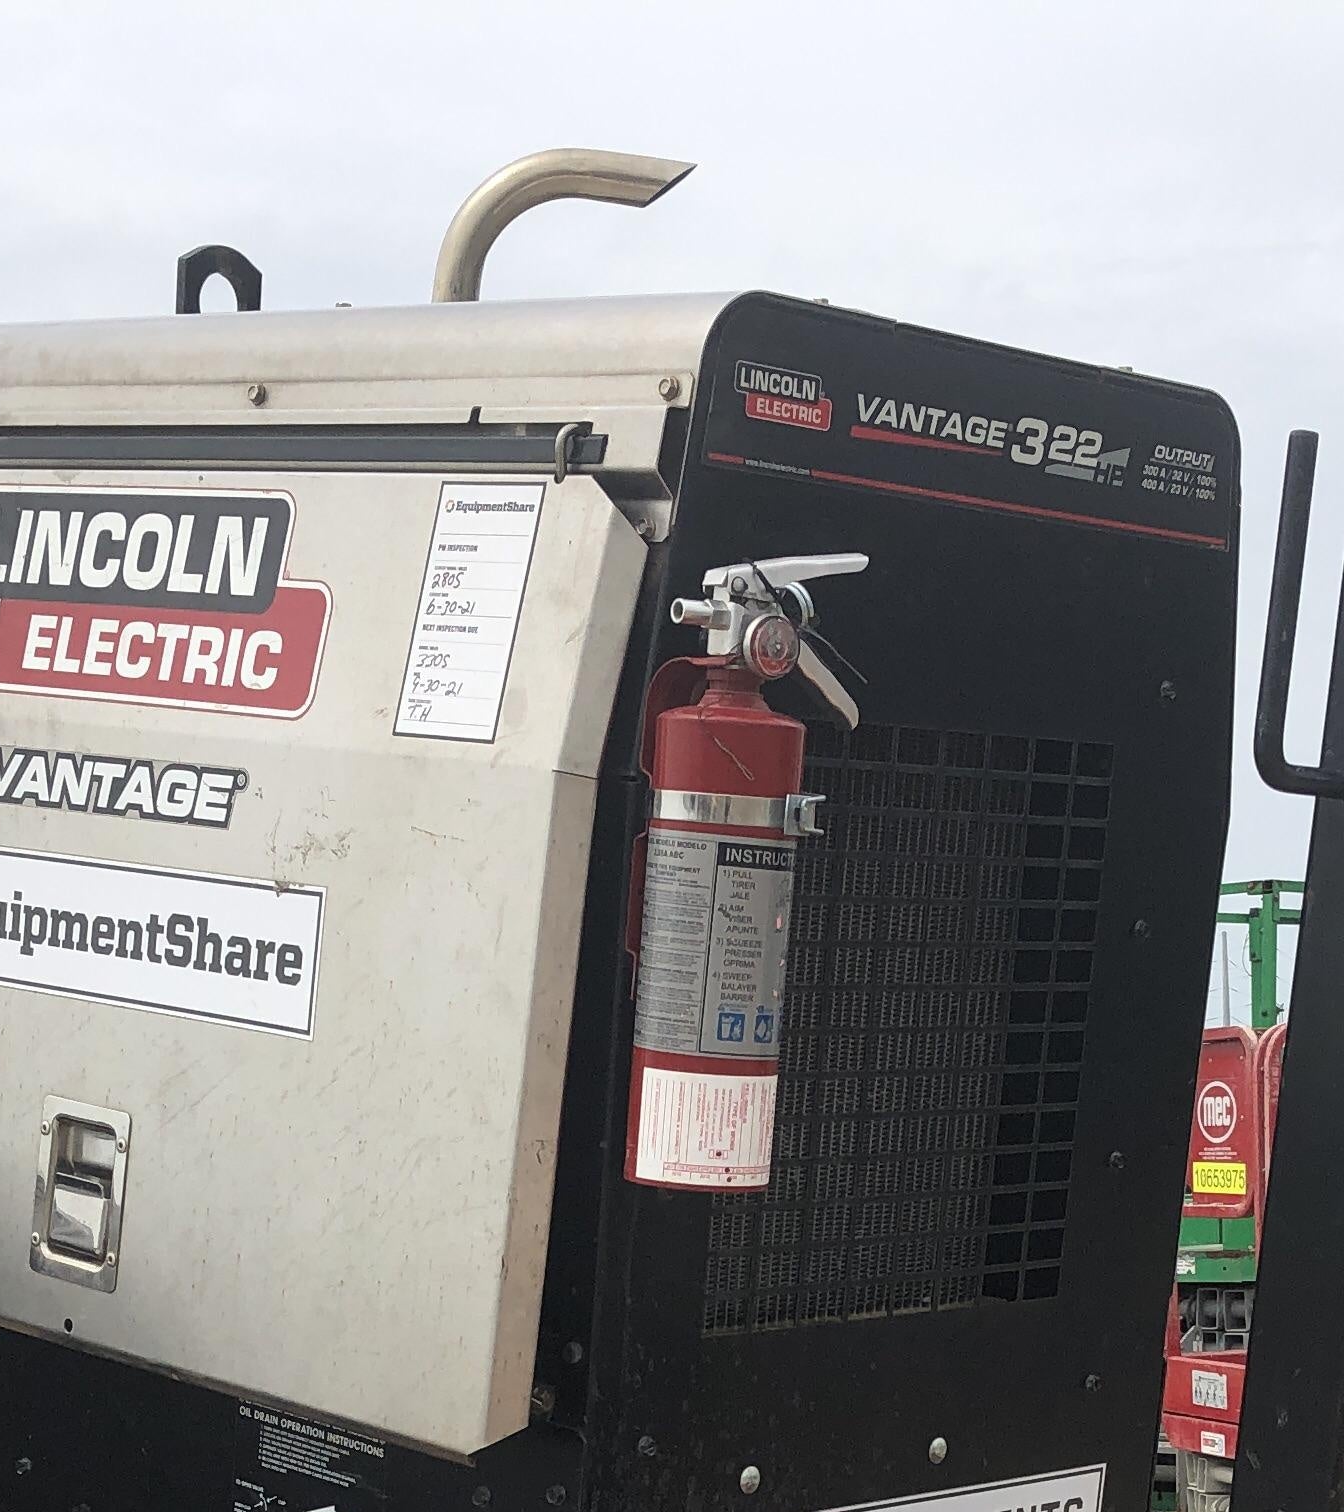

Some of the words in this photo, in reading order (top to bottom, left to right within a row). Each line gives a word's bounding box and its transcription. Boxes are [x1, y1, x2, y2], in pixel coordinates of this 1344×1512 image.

[740, 366, 816, 401] LINCOLN
[756, 397, 822, 424] ELECTRIC
[857, 393, 1008, 448] VANTAGE
[1010, 417, 1103, 467] 322
[1154, 444, 1211, 467] OUTPUT
[1142, 464, 1159, 476] 300
[1160, 467, 1166, 478] A
[1184, 472, 1191, 483] V
[1197, 474, 1216, 488] 100%
[1141, 478, 1158, 490] 400
[1158, 481, 1165, 492] A
[1170, 483, 1182, 495] 23
[1182, 485, 1189, 496] V
[1195, 487, 1216, 501] 100%
[455, 500, 536, 514] EquipmentShare
[431, 572, 464, 589] 2805
[426, 598, 476, 616] 6-30-21
[436, 625, 466, 633] INSPECTION
[21, 615, 284, 691] ELECTRIC
[731, 880, 756, 890] TIRER
[732, 870, 753, 880] PULL
[729, 891, 750, 900] JALE
[725, 925, 759, 935] APUNTE
[722, 972, 752, 980] SWEEP
[721, 982, 757, 992] BALAYER
[1203, 1095, 1231, 1127] mec
[1195, 1168, 1245, 1190] 10653975
[239, 1405, 252, 1418] OIL
[254, 1410, 278, 1426] DRAIN
[280, 1418, 325, 1440] OPERATION
[326, 1431, 385, 1458] INSTRUCTIONS
